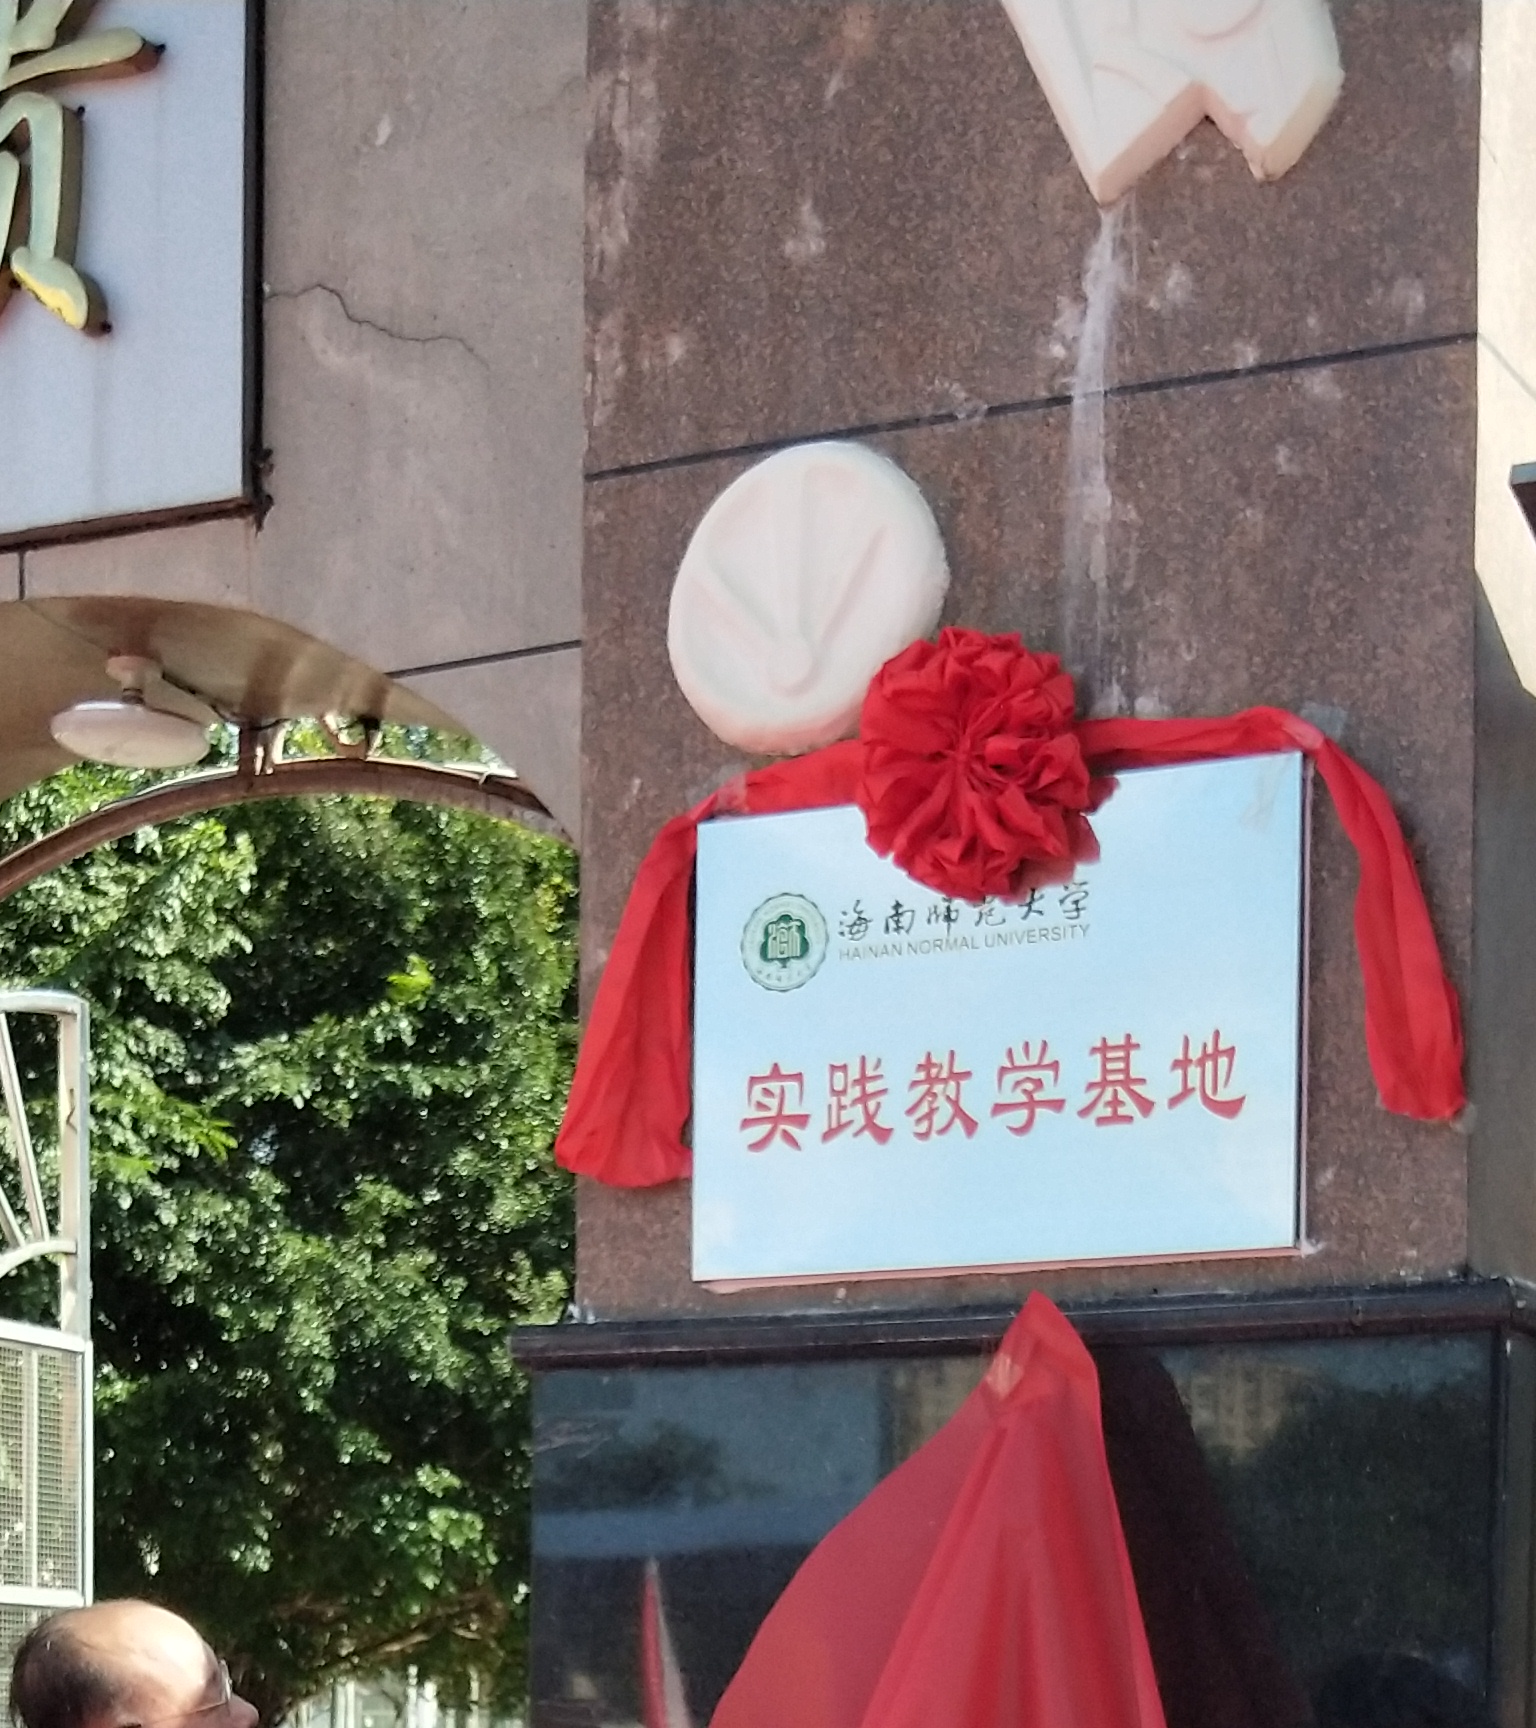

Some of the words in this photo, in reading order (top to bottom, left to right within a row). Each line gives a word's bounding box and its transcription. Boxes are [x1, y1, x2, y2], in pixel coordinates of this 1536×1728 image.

[838, 944, 903, 962] HAINAN
[906, 936, 980, 956] NORMAL
[984, 923, 1091, 949] UNIVERSITY
[739, 1029, 1247, 1153] 实践教学基地
